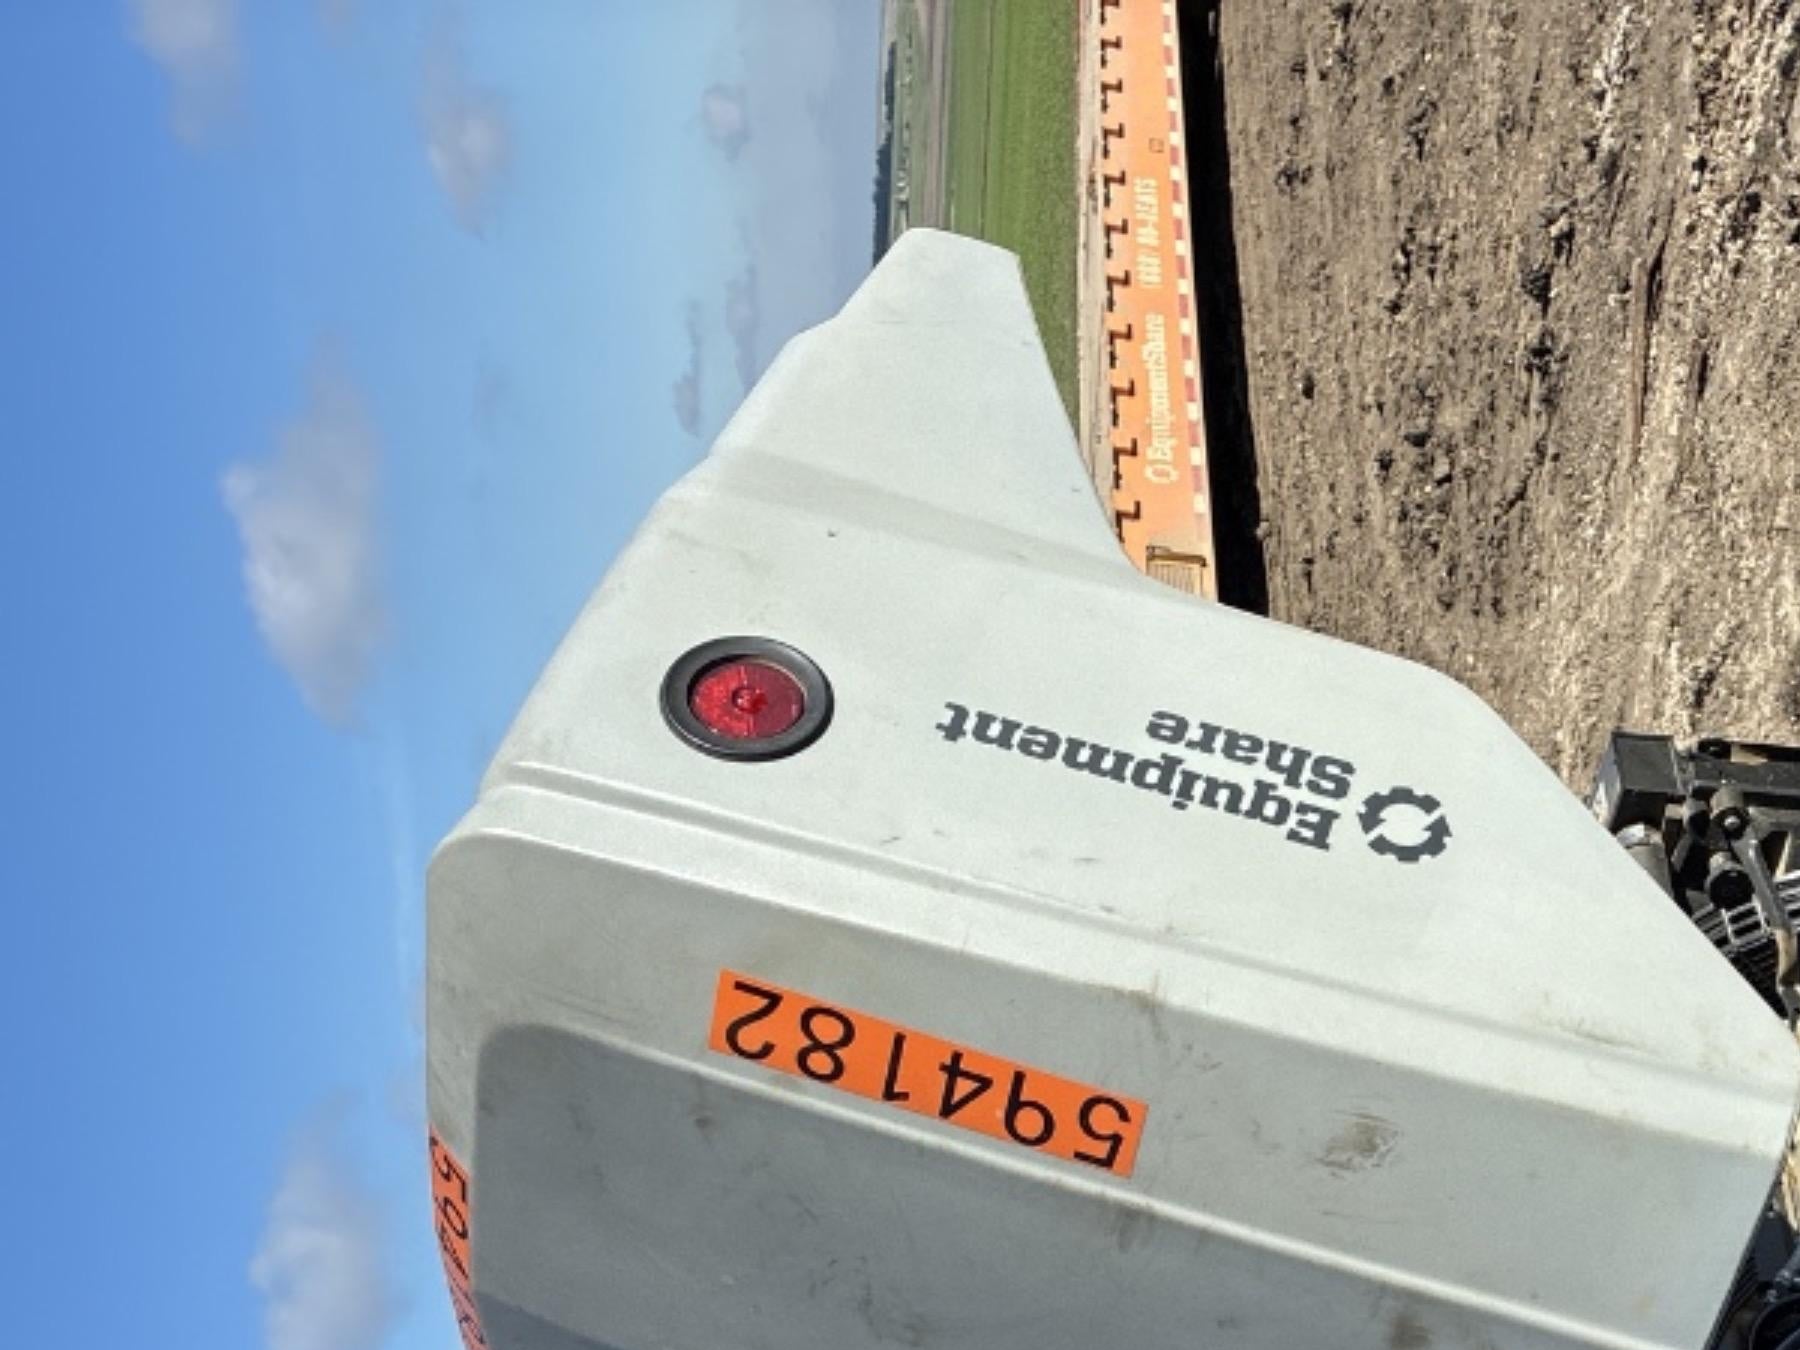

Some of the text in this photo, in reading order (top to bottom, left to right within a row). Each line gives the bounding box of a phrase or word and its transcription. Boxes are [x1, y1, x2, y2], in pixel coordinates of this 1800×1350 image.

[935, 702, 1343, 850] Equipment
[1144, 709, 1357, 800] Share
[722, 979, 1133, 1169] 594182
